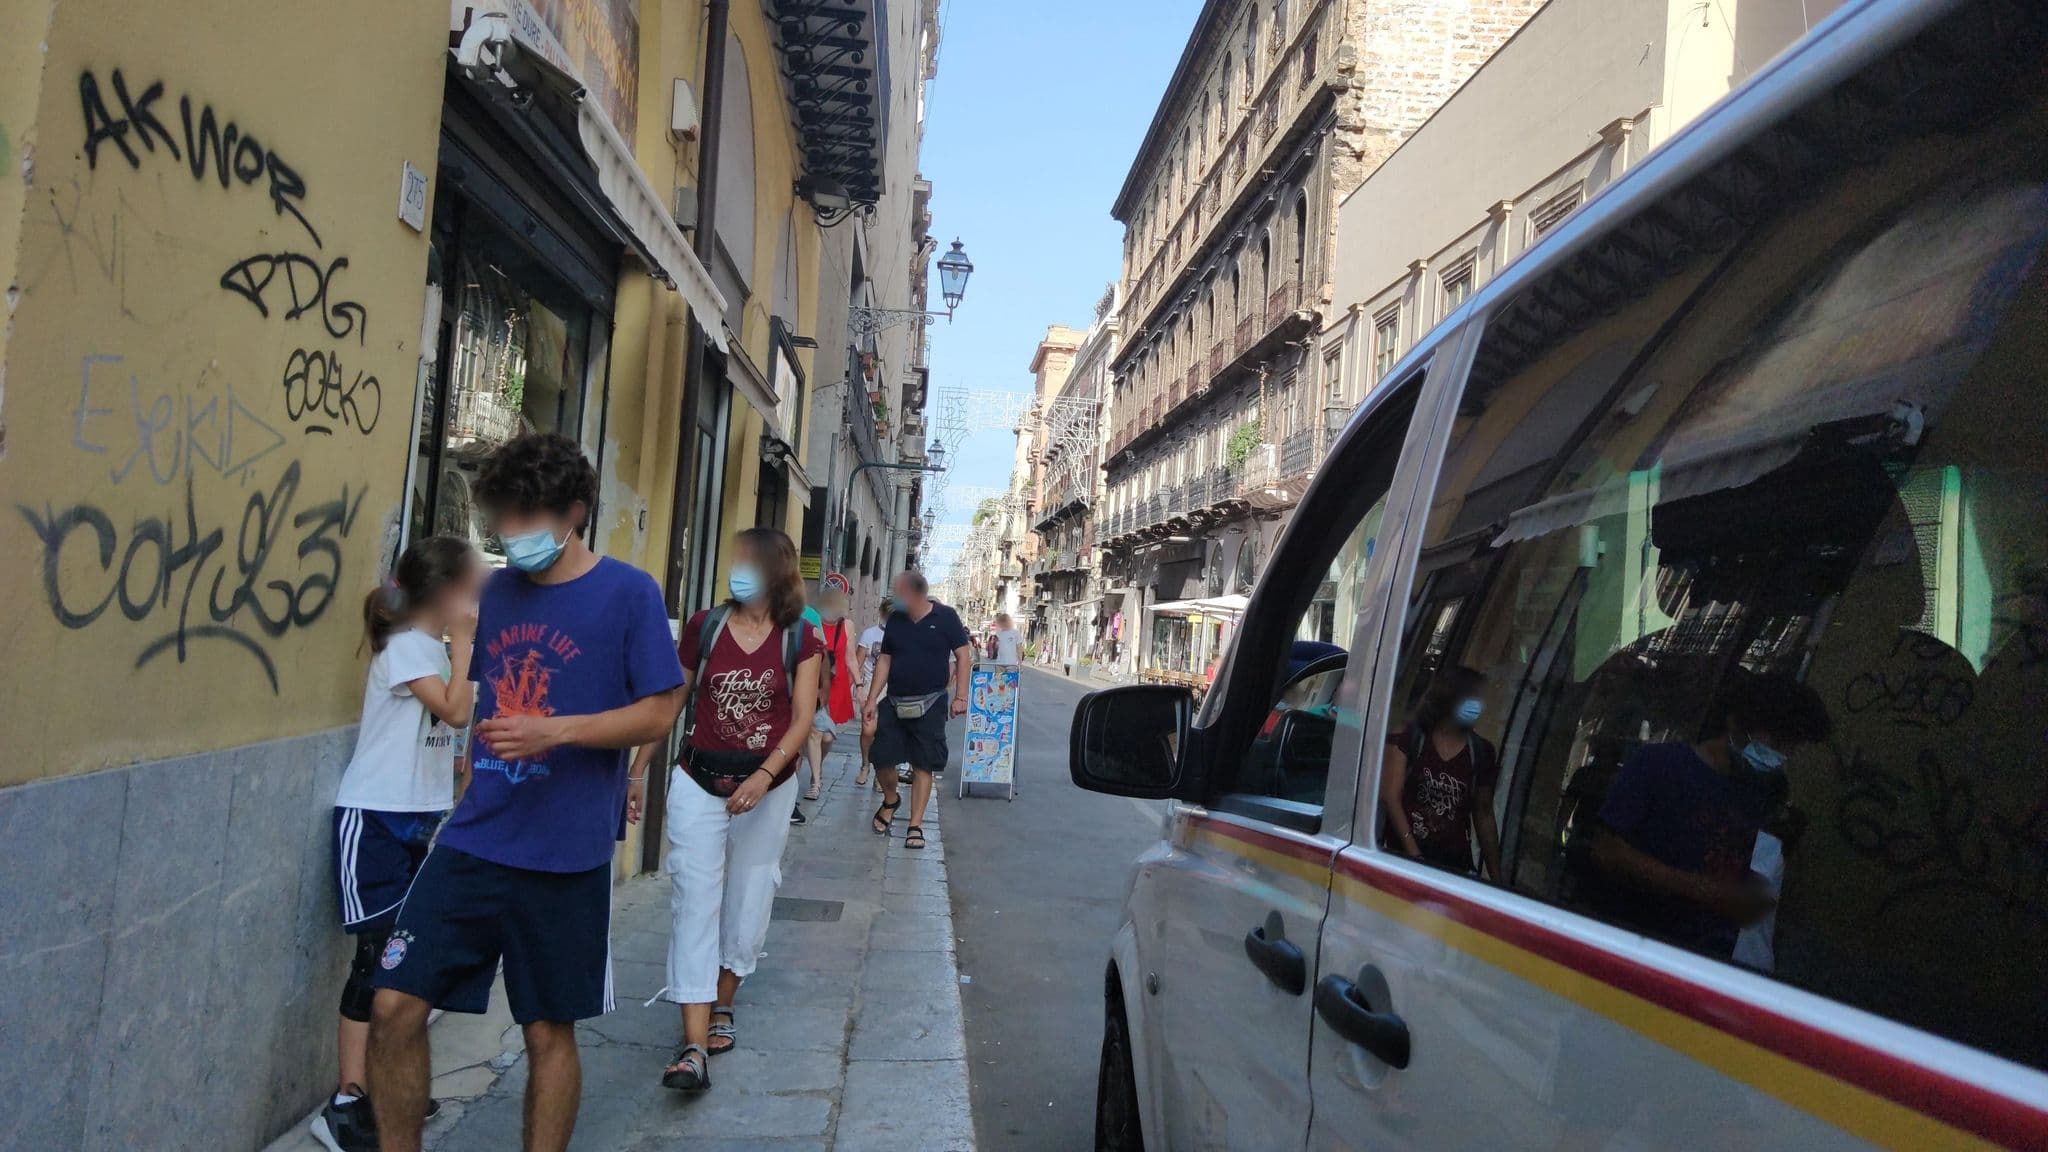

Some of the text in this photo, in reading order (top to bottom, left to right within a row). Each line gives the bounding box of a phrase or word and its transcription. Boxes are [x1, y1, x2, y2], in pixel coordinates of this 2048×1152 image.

[406, 170, 425, 210] 275
[486, 623, 584, 665] MARINE LIFE
[711, 668, 775, 698] Hard
[717, 692, 771, 720] Rock
